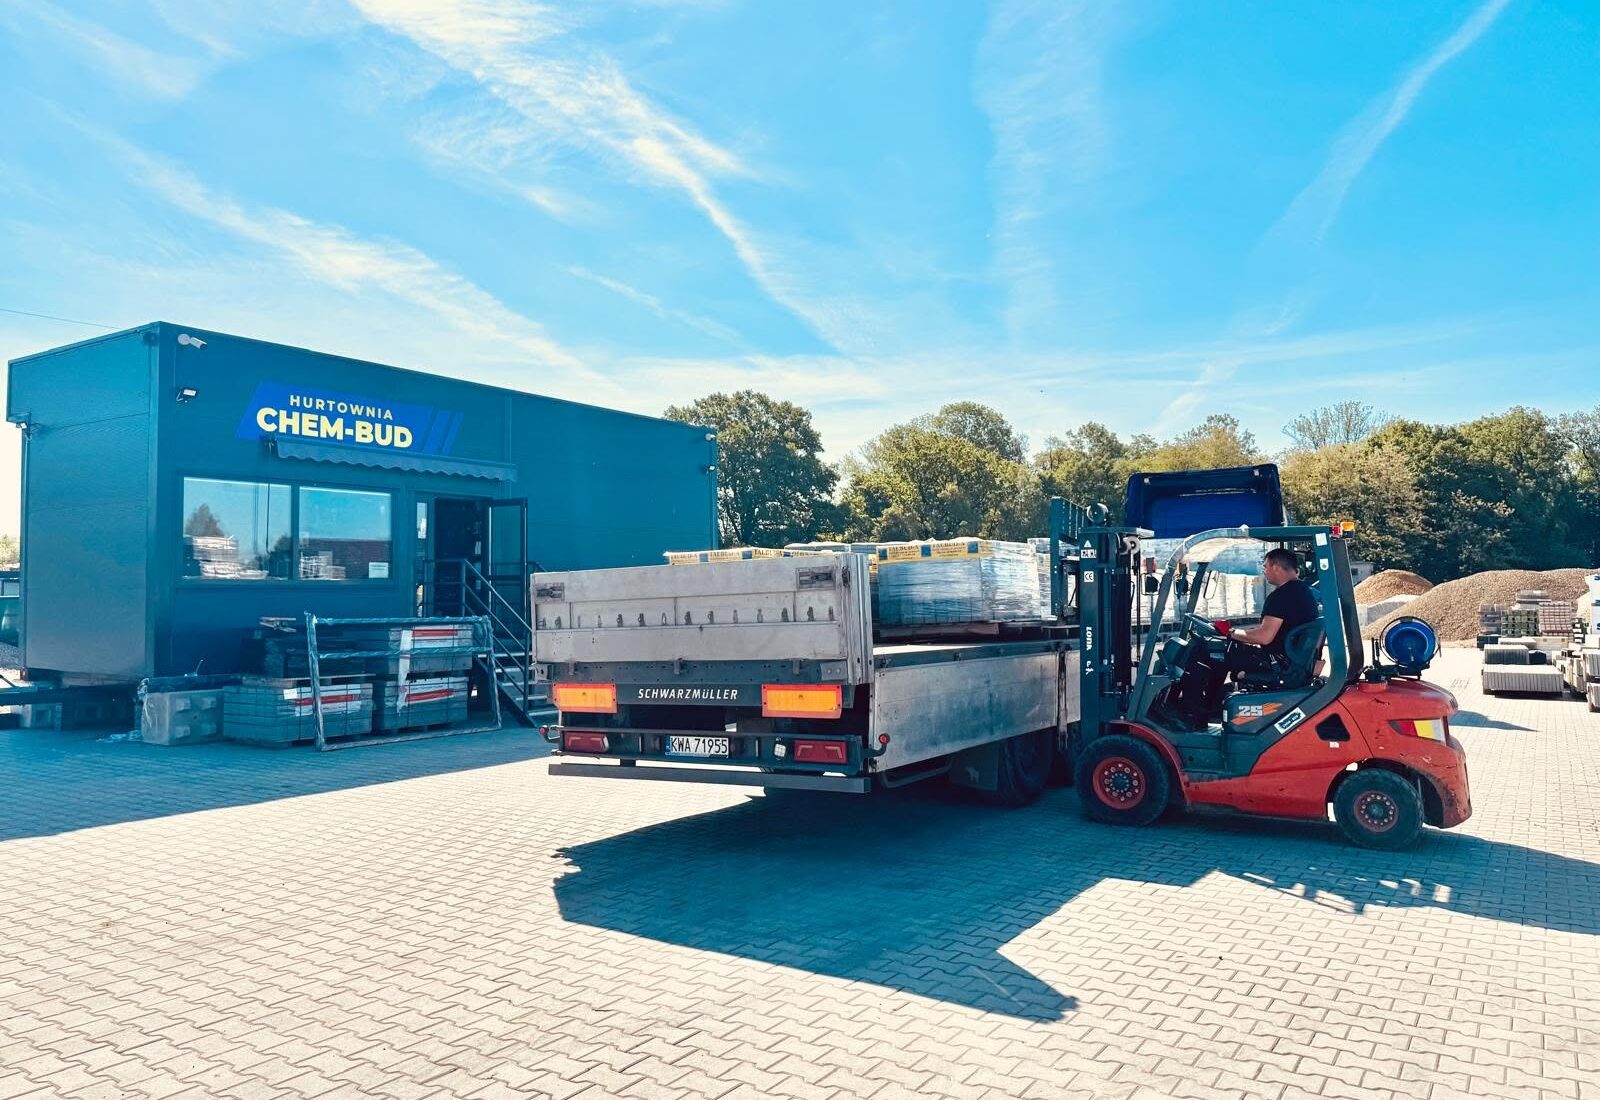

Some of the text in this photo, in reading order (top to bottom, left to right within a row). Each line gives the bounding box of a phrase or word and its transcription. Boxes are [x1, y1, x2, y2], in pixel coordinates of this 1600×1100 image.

[289, 395, 393, 420] HURTOWNIA
[256, 407, 413, 448] CHEM-BUD
[638, 688, 738, 700] SCHWARZMÜLLER
[1239, 705, 1263, 717] 25
[671, 738, 691, 752] KWA
[694, 739, 728, 753] 71955
